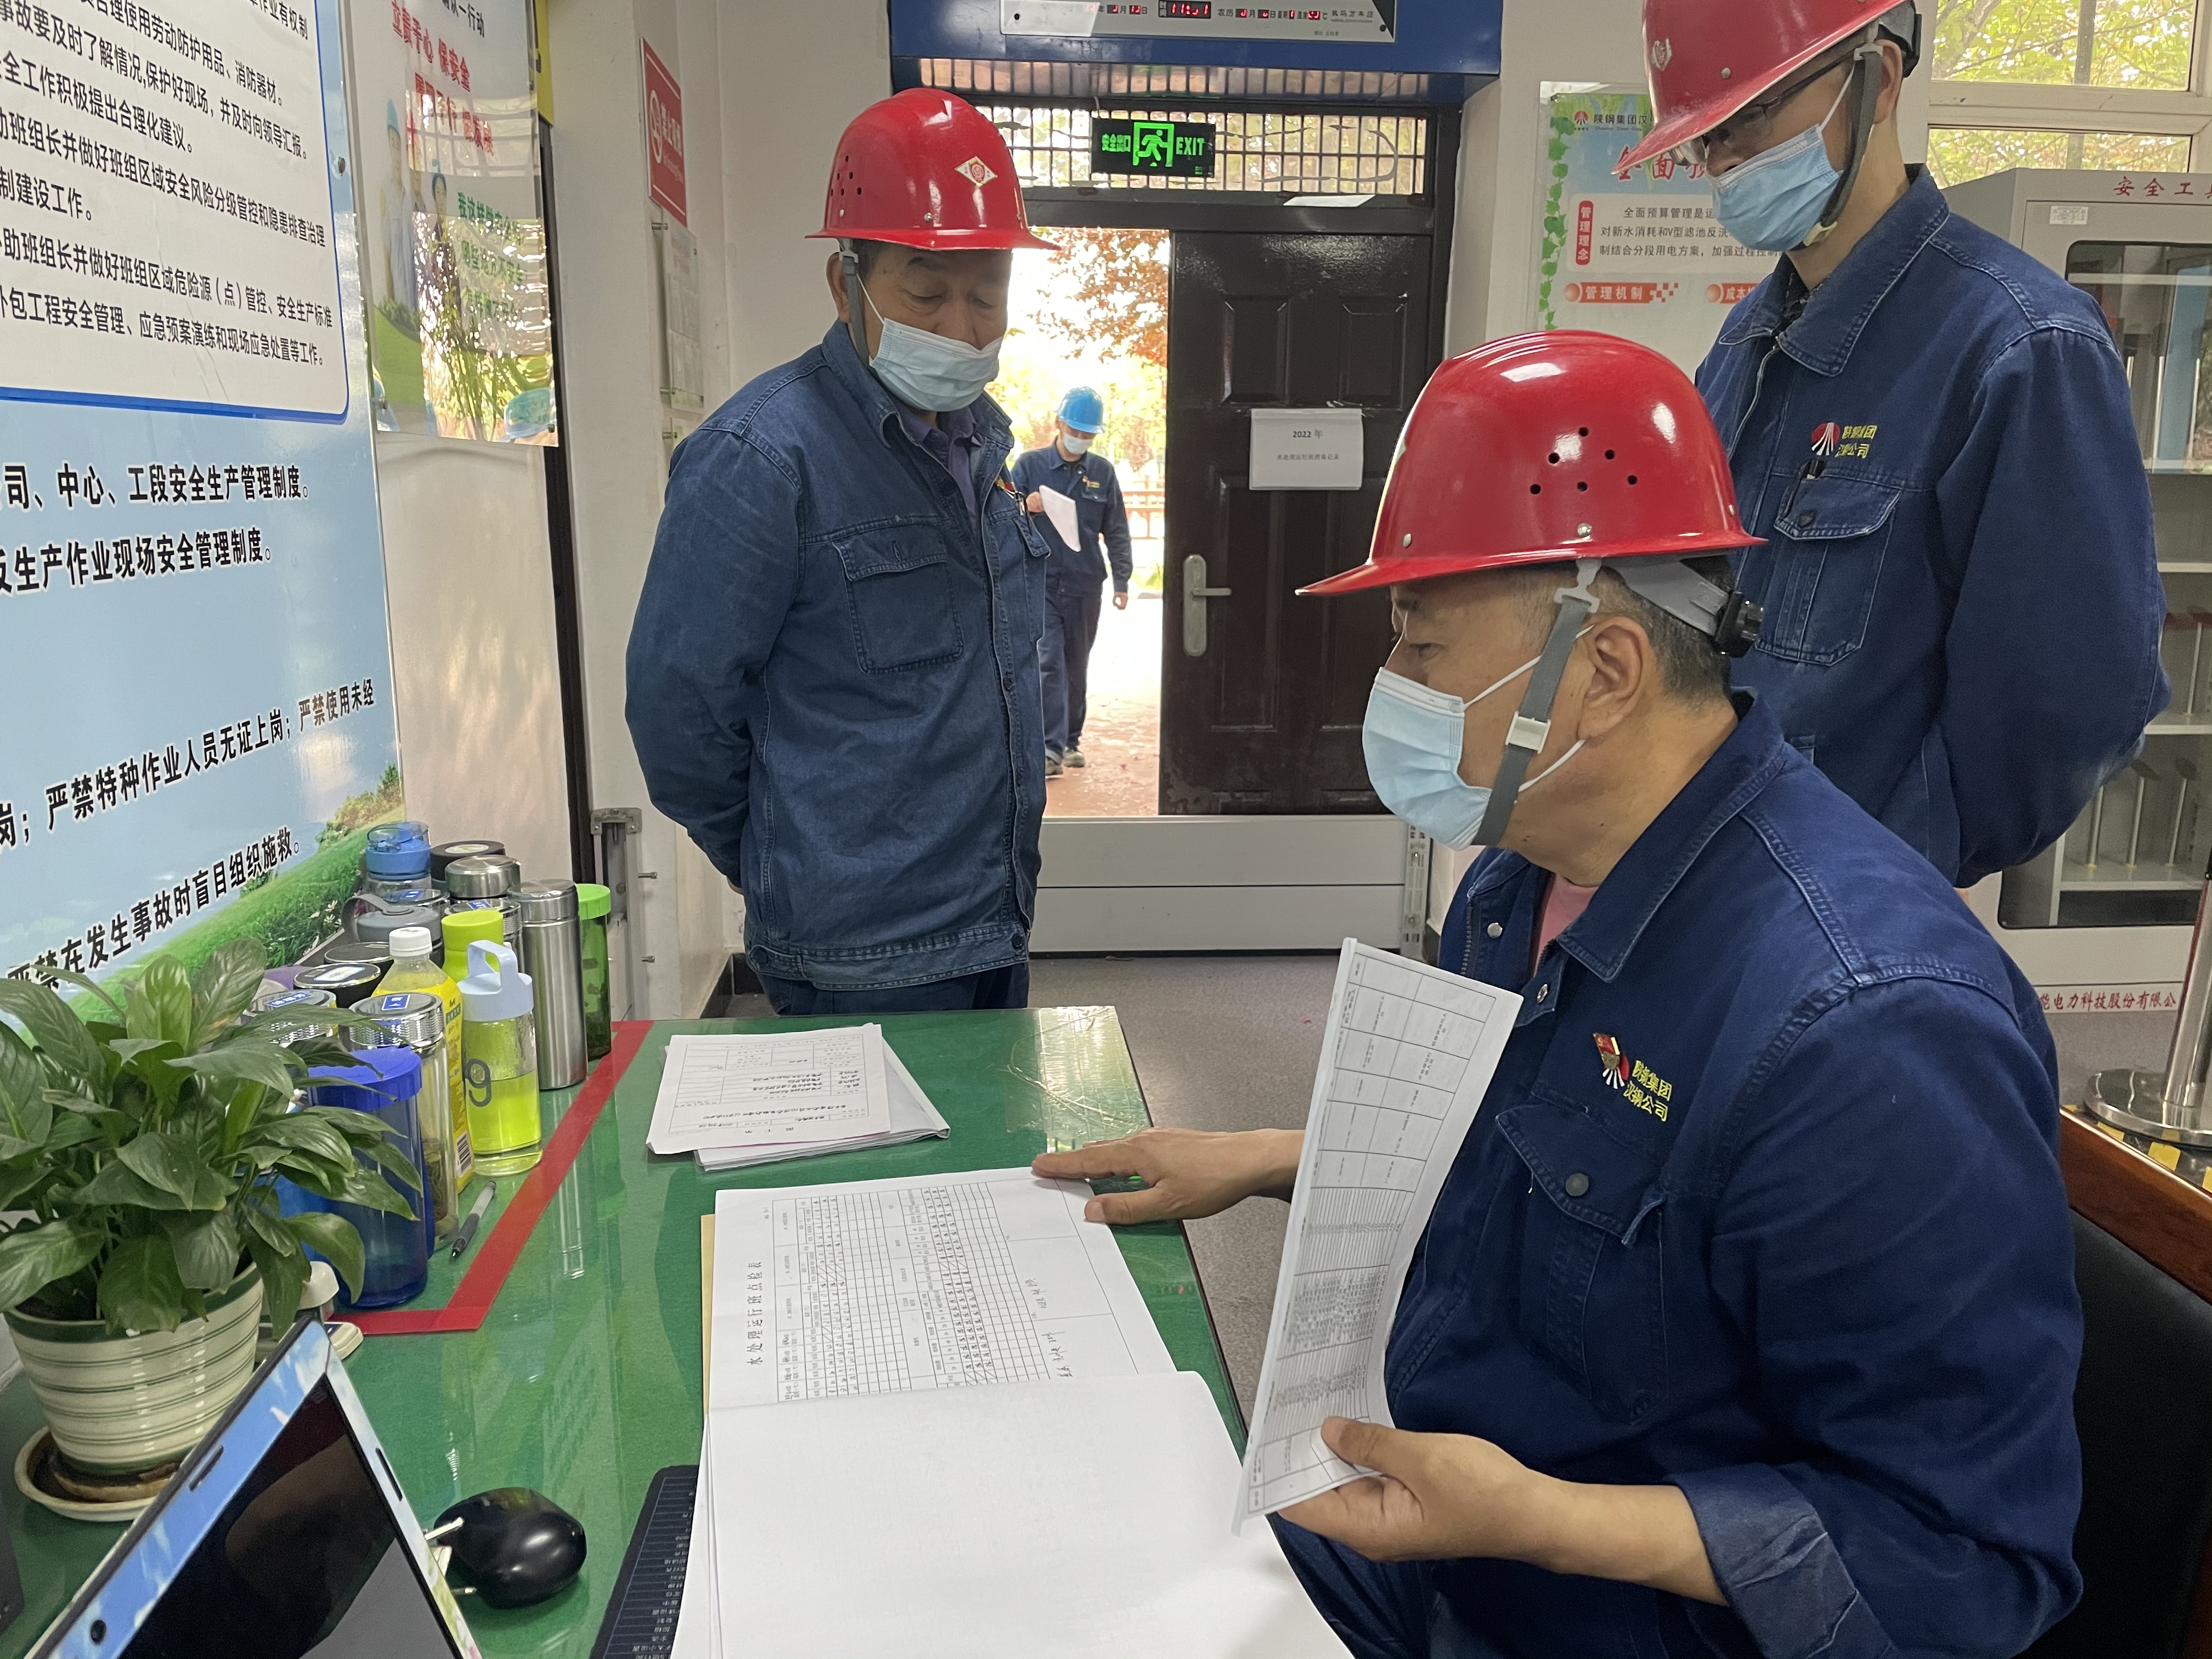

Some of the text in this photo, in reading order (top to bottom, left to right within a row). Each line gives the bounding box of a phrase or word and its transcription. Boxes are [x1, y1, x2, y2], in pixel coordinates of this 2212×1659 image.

[250, 0, 308, 40] 作业有权制
[1217, 9, 1234, 17] 农历
[0, 50, 193, 154] 全工作积极提出合理化建议。
[1594, 114, 1652, 125] 陕钢集团汉
[1102, 133, 1131, 153] 安全出口
[1176, 137, 1205, 156] EXIT
[0, 168, 92, 221] 制建设工作。
[1578, 206, 1592, 261] 管理理念
[0, 228, 334, 329] 助班组长并做好班组区域危险源（点）管控、安全生产标准
[1585, 286, 1643, 301] 管理机制
[1293, 429, 1324, 439] 2022 年
[4, 463, 308, 510] 司、中心、工段安全生产管理制度。
[746, 1261, 763, 1367] 水处理运行班点检表
